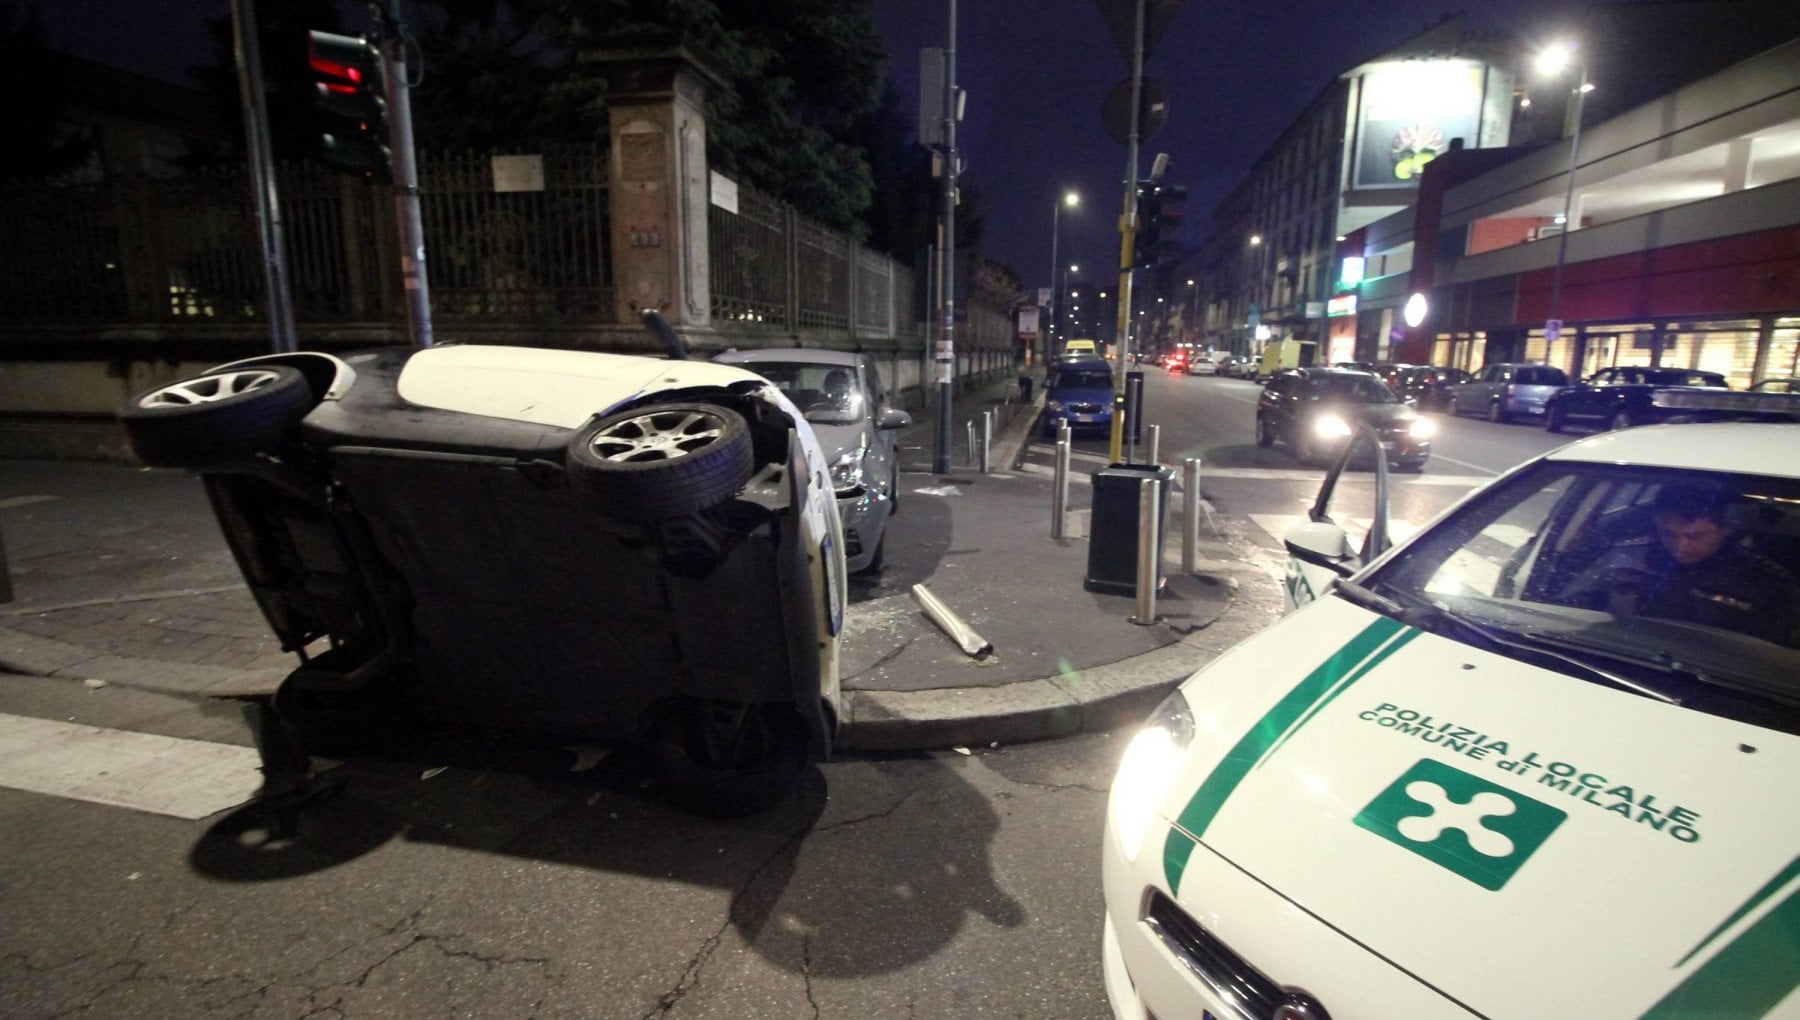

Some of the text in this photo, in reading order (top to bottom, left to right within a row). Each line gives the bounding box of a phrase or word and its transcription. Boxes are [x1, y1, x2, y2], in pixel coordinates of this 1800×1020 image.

[1358, 710, 1700, 843] COMUNE di MILANO
[1374, 702, 1701, 827] POLIZIA LOCALE
